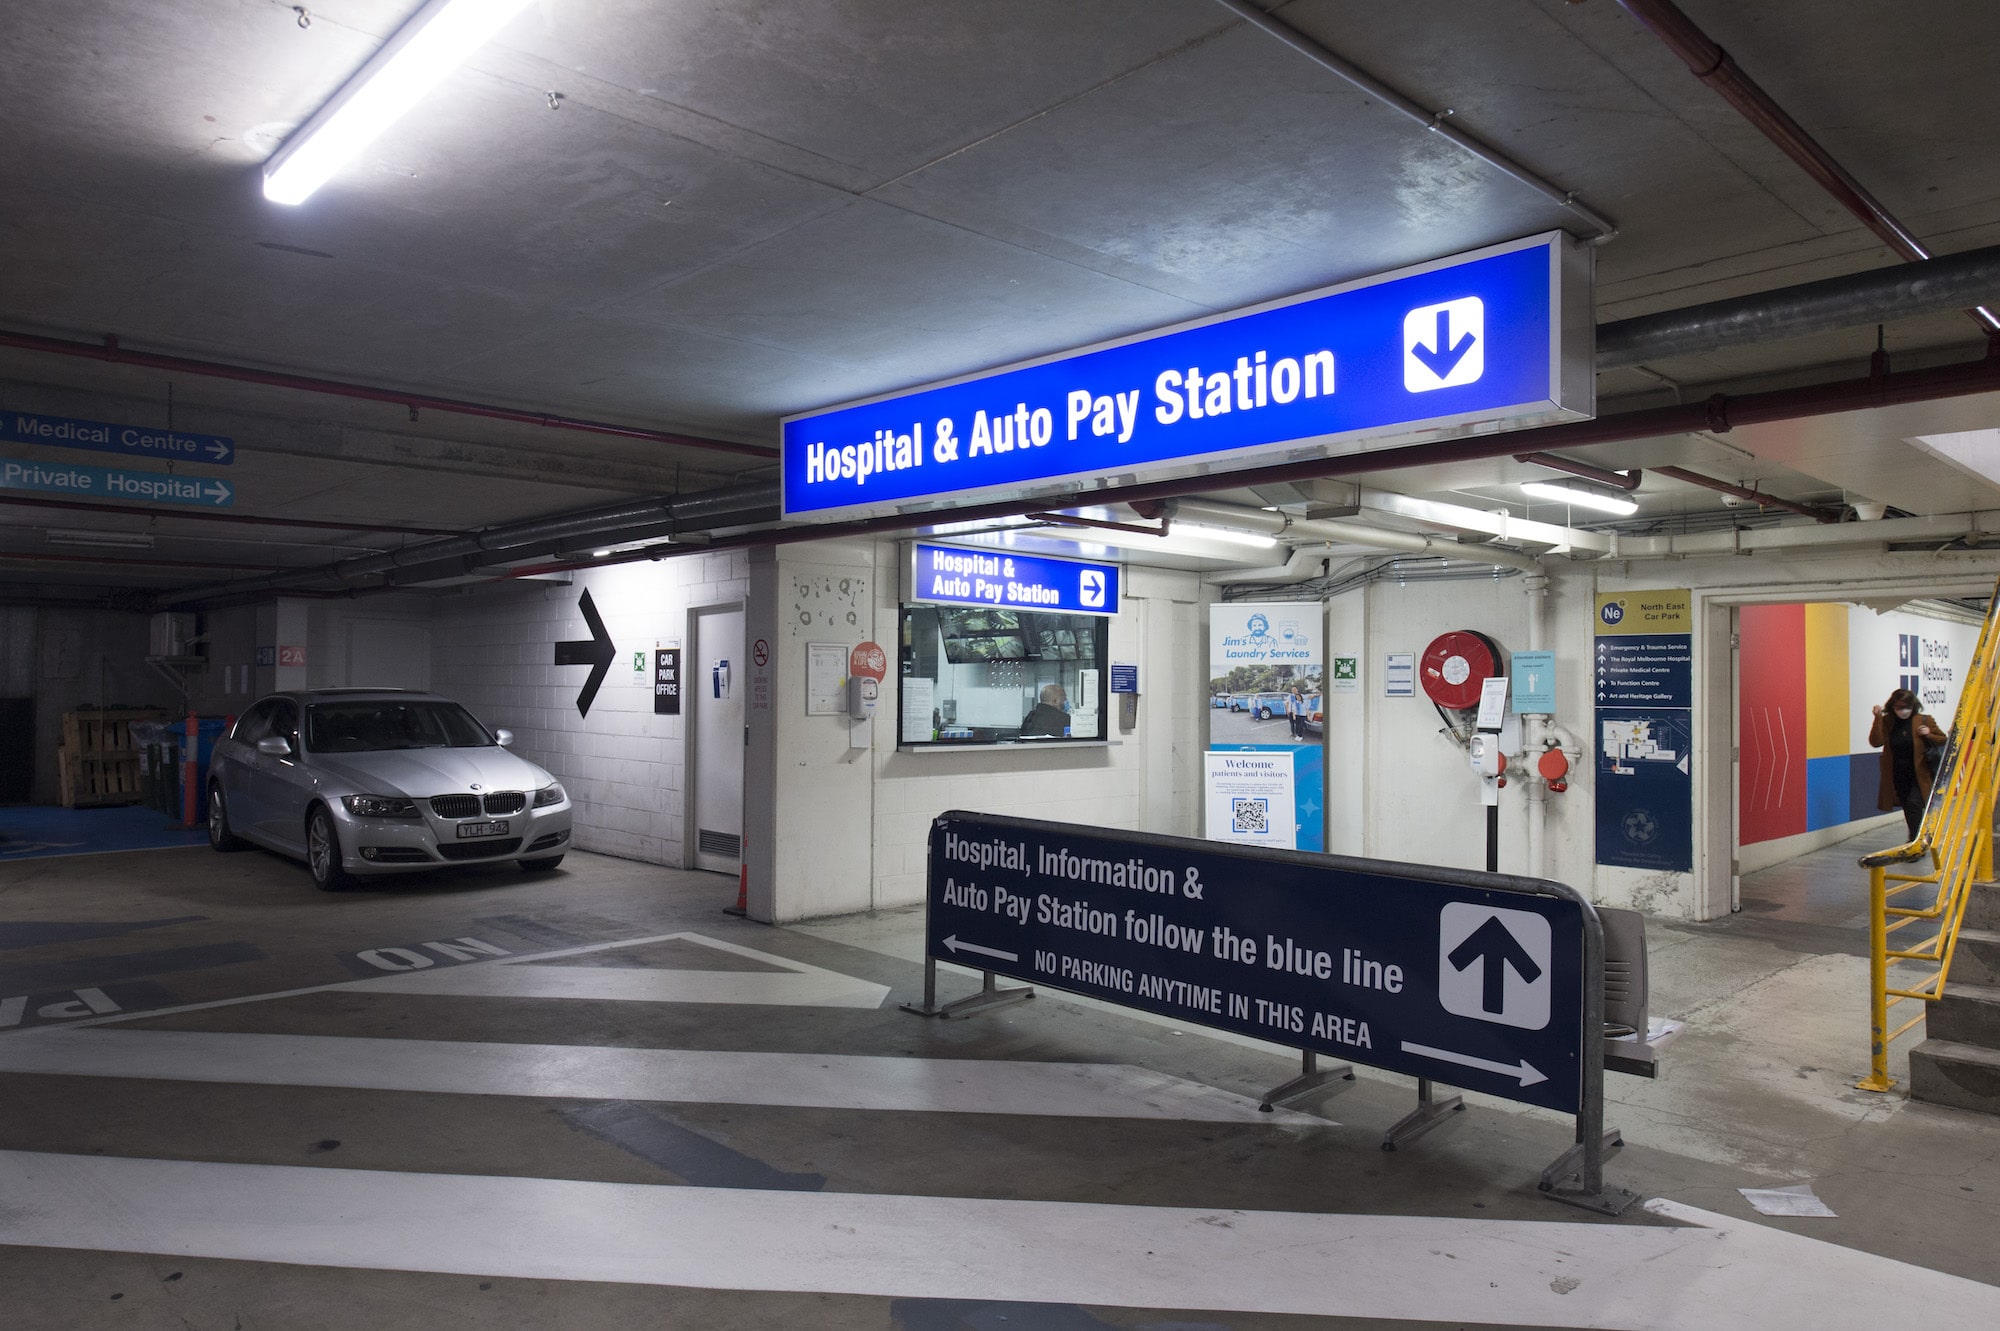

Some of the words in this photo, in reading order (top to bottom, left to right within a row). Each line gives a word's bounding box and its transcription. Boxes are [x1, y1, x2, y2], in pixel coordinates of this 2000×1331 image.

[805, 425, 922, 483] Hospital
[933, 416, 959, 463] &
[968, 408, 1053, 451] Auto
[1066, 388, 1140, 444] Pay
[1155, 348, 1335, 425] Station
[17, 416, 109, 444] Medical
[121, 429, 197, 452] Centre
[4, 463, 92, 489] Private
[107, 473, 200, 499] Hospital
[933, 550, 999, 577] Hospital
[1003, 558, 1015, 578] &
[932, 575, 970, 598] Auto
[975, 578, 1003, 604] Pay
[1007, 581, 1060, 605] Station
[1604, 607, 1620, 619] Ne
[1661, 612, 1681, 620] Park
[1666, 602, 1685, 610] East
[1222, 636, 1247, 646] Jim's
[1922, 639, 1933, 658] The
[1934, 640, 1949, 663] Royal
[660, 653, 674, 666] CAR
[1226, 648, 1267, 660] Laundry
[1269, 648, 1310, 658] Services
[658, 669, 675, 681] PARK
[1923, 662, 1952, 681] Melbourne
[656, 683, 677, 695] OFFICE
[1923, 686, 1947, 709] Hospital
[1211, 770, 1242, 778] patients
[1243, 770, 1258, 778] and
[1259, 770, 1288, 778] visitors
[1225, 759, 1274, 769] Welcome
[944, 832, 1031, 877] Hospital,
[1038, 844, 1175, 896] Information
[1182, 866, 1204, 900] &
[943, 877, 988, 912] Auto
[994, 886, 1031, 926] Pay
[1037, 893, 1117, 938] Station
[1125, 909, 1204, 954] follow
[1212, 925, 1257, 965] the
[1266, 934, 1332, 980] blue
[1343, 947, 1404, 994] line
[356, 936, 514, 971] NO
[1035, 949, 1057, 975] NO
[1061, 955, 1134, 993] PARKING
[1138, 974, 1222, 1015] ANYTIME
[1228, 992, 1249, 1021] IN
[1255, 998, 1304, 1034] THIS
[1311, 1011, 1373, 1050] AREA
